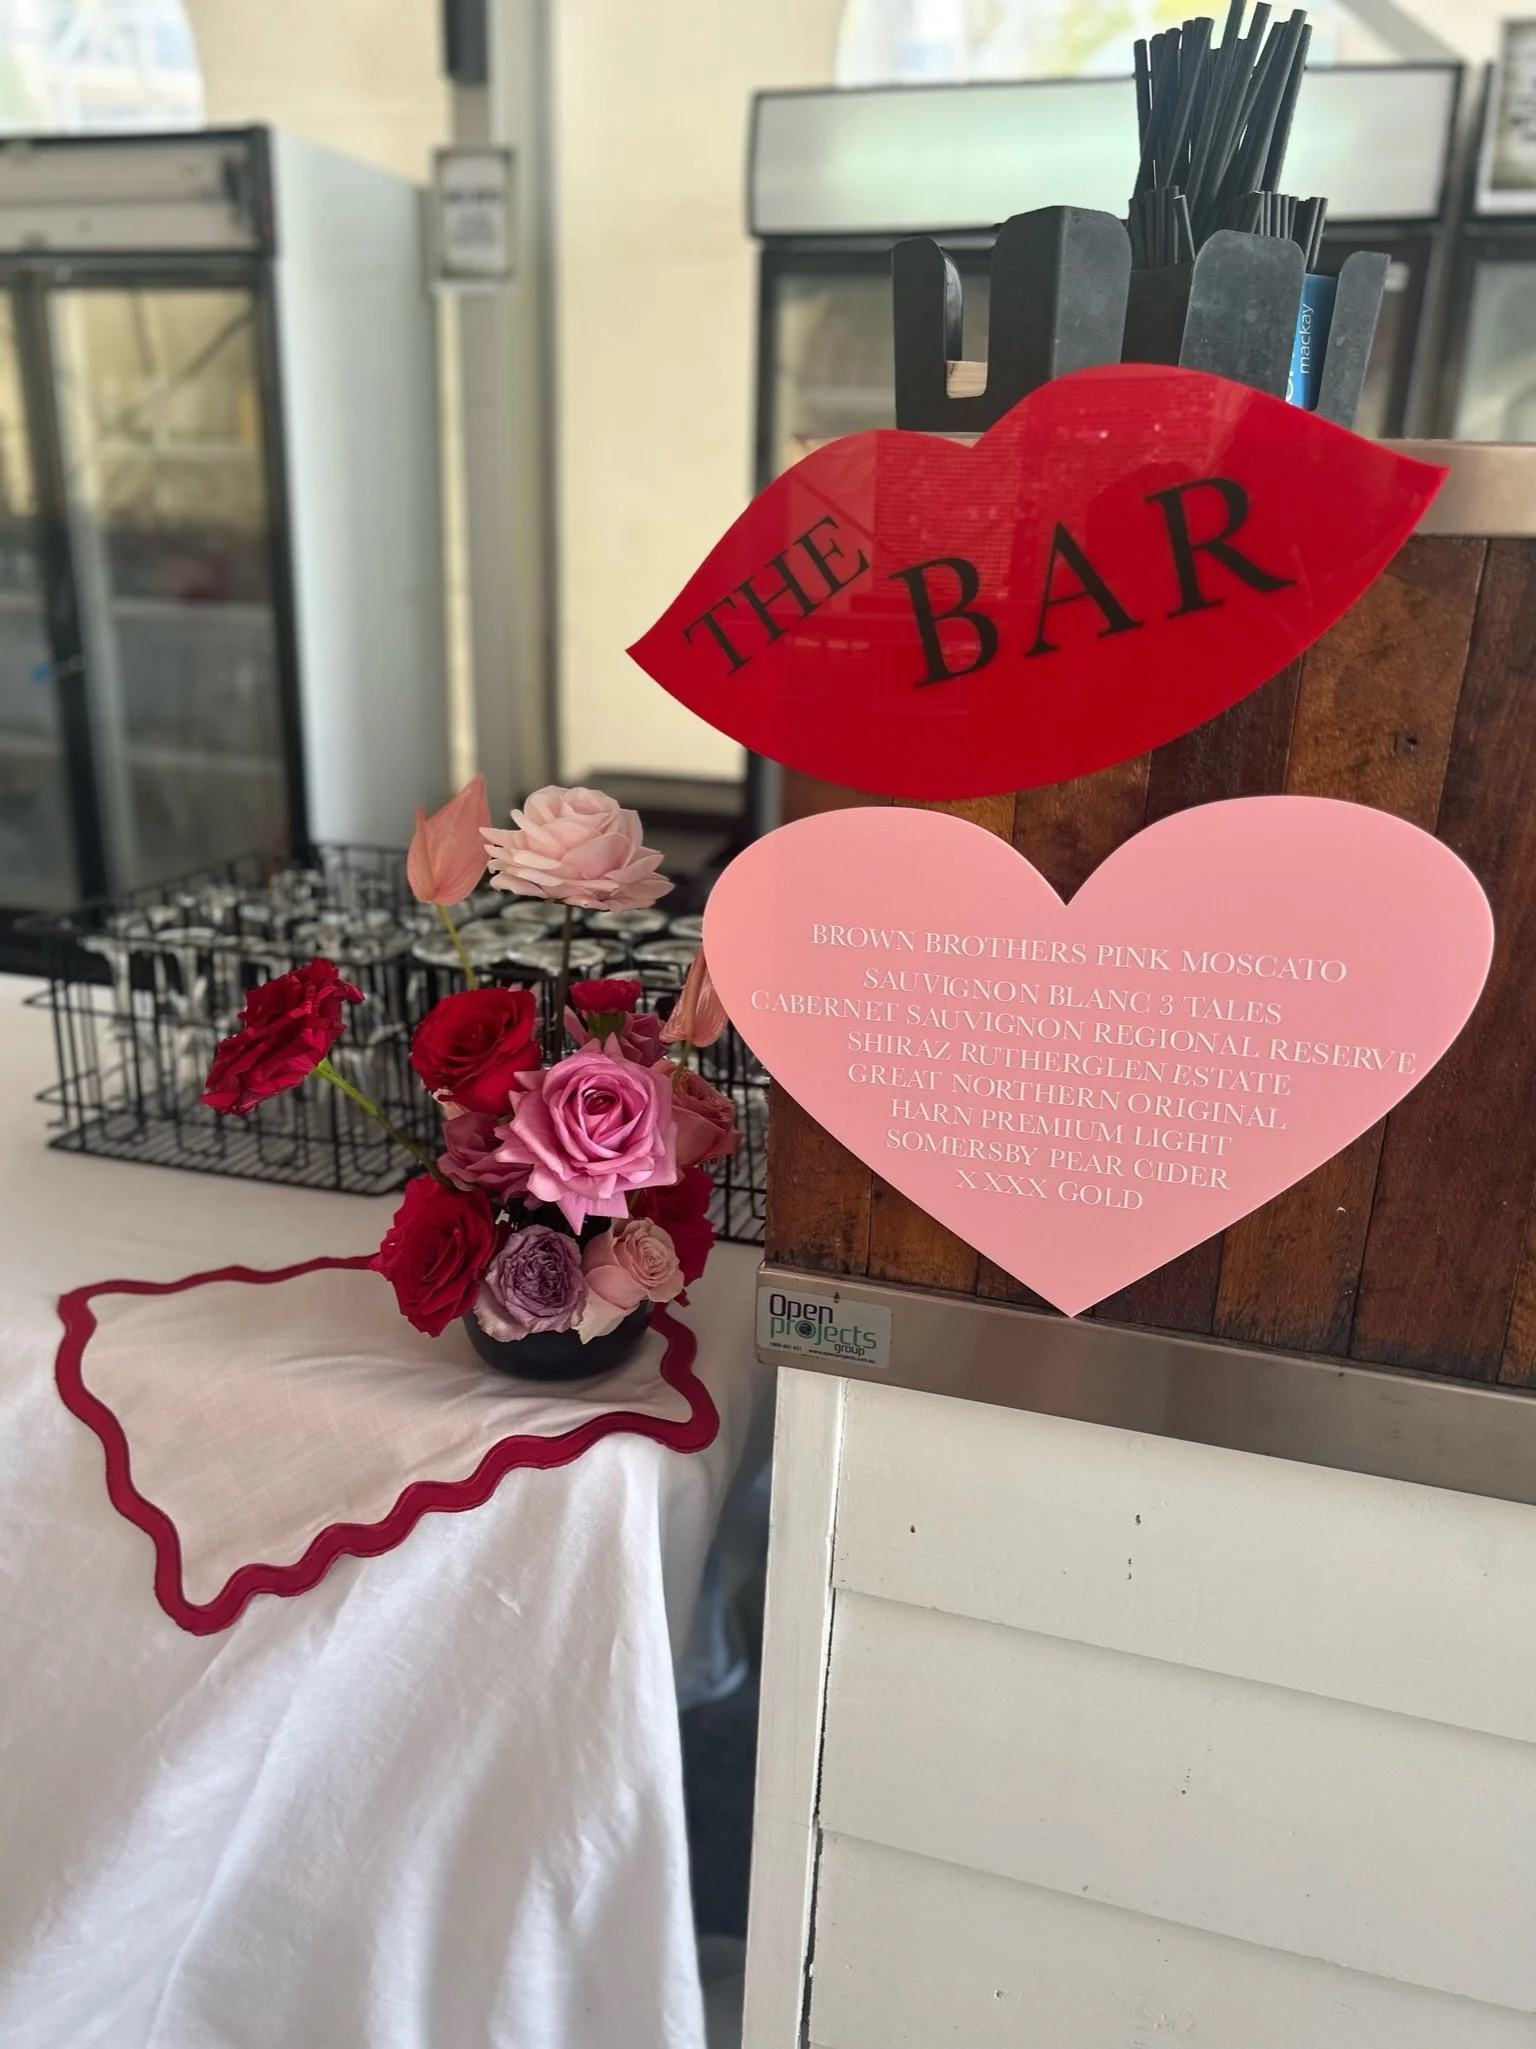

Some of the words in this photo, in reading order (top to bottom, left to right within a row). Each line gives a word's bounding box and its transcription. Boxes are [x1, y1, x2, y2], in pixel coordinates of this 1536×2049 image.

[1299, 303, 1314, 374] mackay
[681, 515, 870, 675] THE
[888, 476, 1298, 688] BAR
[811, 923, 916, 952] BROWN
[924, 932, 1087, 965] BROTHERS
[1096, 943, 1172, 972] PINK
[1181, 949, 1347, 983] MOSCATO
[863, 967, 1040, 1005] SAUVIGNON
[1048, 984, 1151, 1014] BLANC
[1159, 994, 1174, 1016] 3
[1183, 996, 1282, 1025] TALES
[750, 990, 899, 1022] CABERNET
[906, 1004, 1085, 1043] SAUVIGNON
[1094, 1022, 1259, 1058] REGIONAL
[1268, 1038, 1416, 1075] RESERVE
[847, 1031, 951, 1061] SHIRAZ
[960, 1042, 1168, 1082] RUTHERGLEN
[1172, 1064, 1291, 1096] ESTATE
[848, 1063, 942, 1091] GREAT
[951, 1073, 1122, 1112] NORTHERN
[1127, 1092, 1286, 1130] ORIGINAL
[890, 1098, 974, 1126] HARN
[980, 1109, 1124, 1144] PREMIUM
[1134, 1126, 1232, 1156] LIGHT
[886, 1128, 1039, 1166] SOMERSBY
[1048, 1148, 1124, 1178] PEAR
[1133, 1158, 1230, 1190] CIDER
[955, 1168, 1049, 1199] XXXX
[1057, 1180, 1144, 1211] GOLD
[770, 1293, 833, 1324] Open
[770, 1317, 877, 1350] projects
[834, 1343, 865, 1356] group
